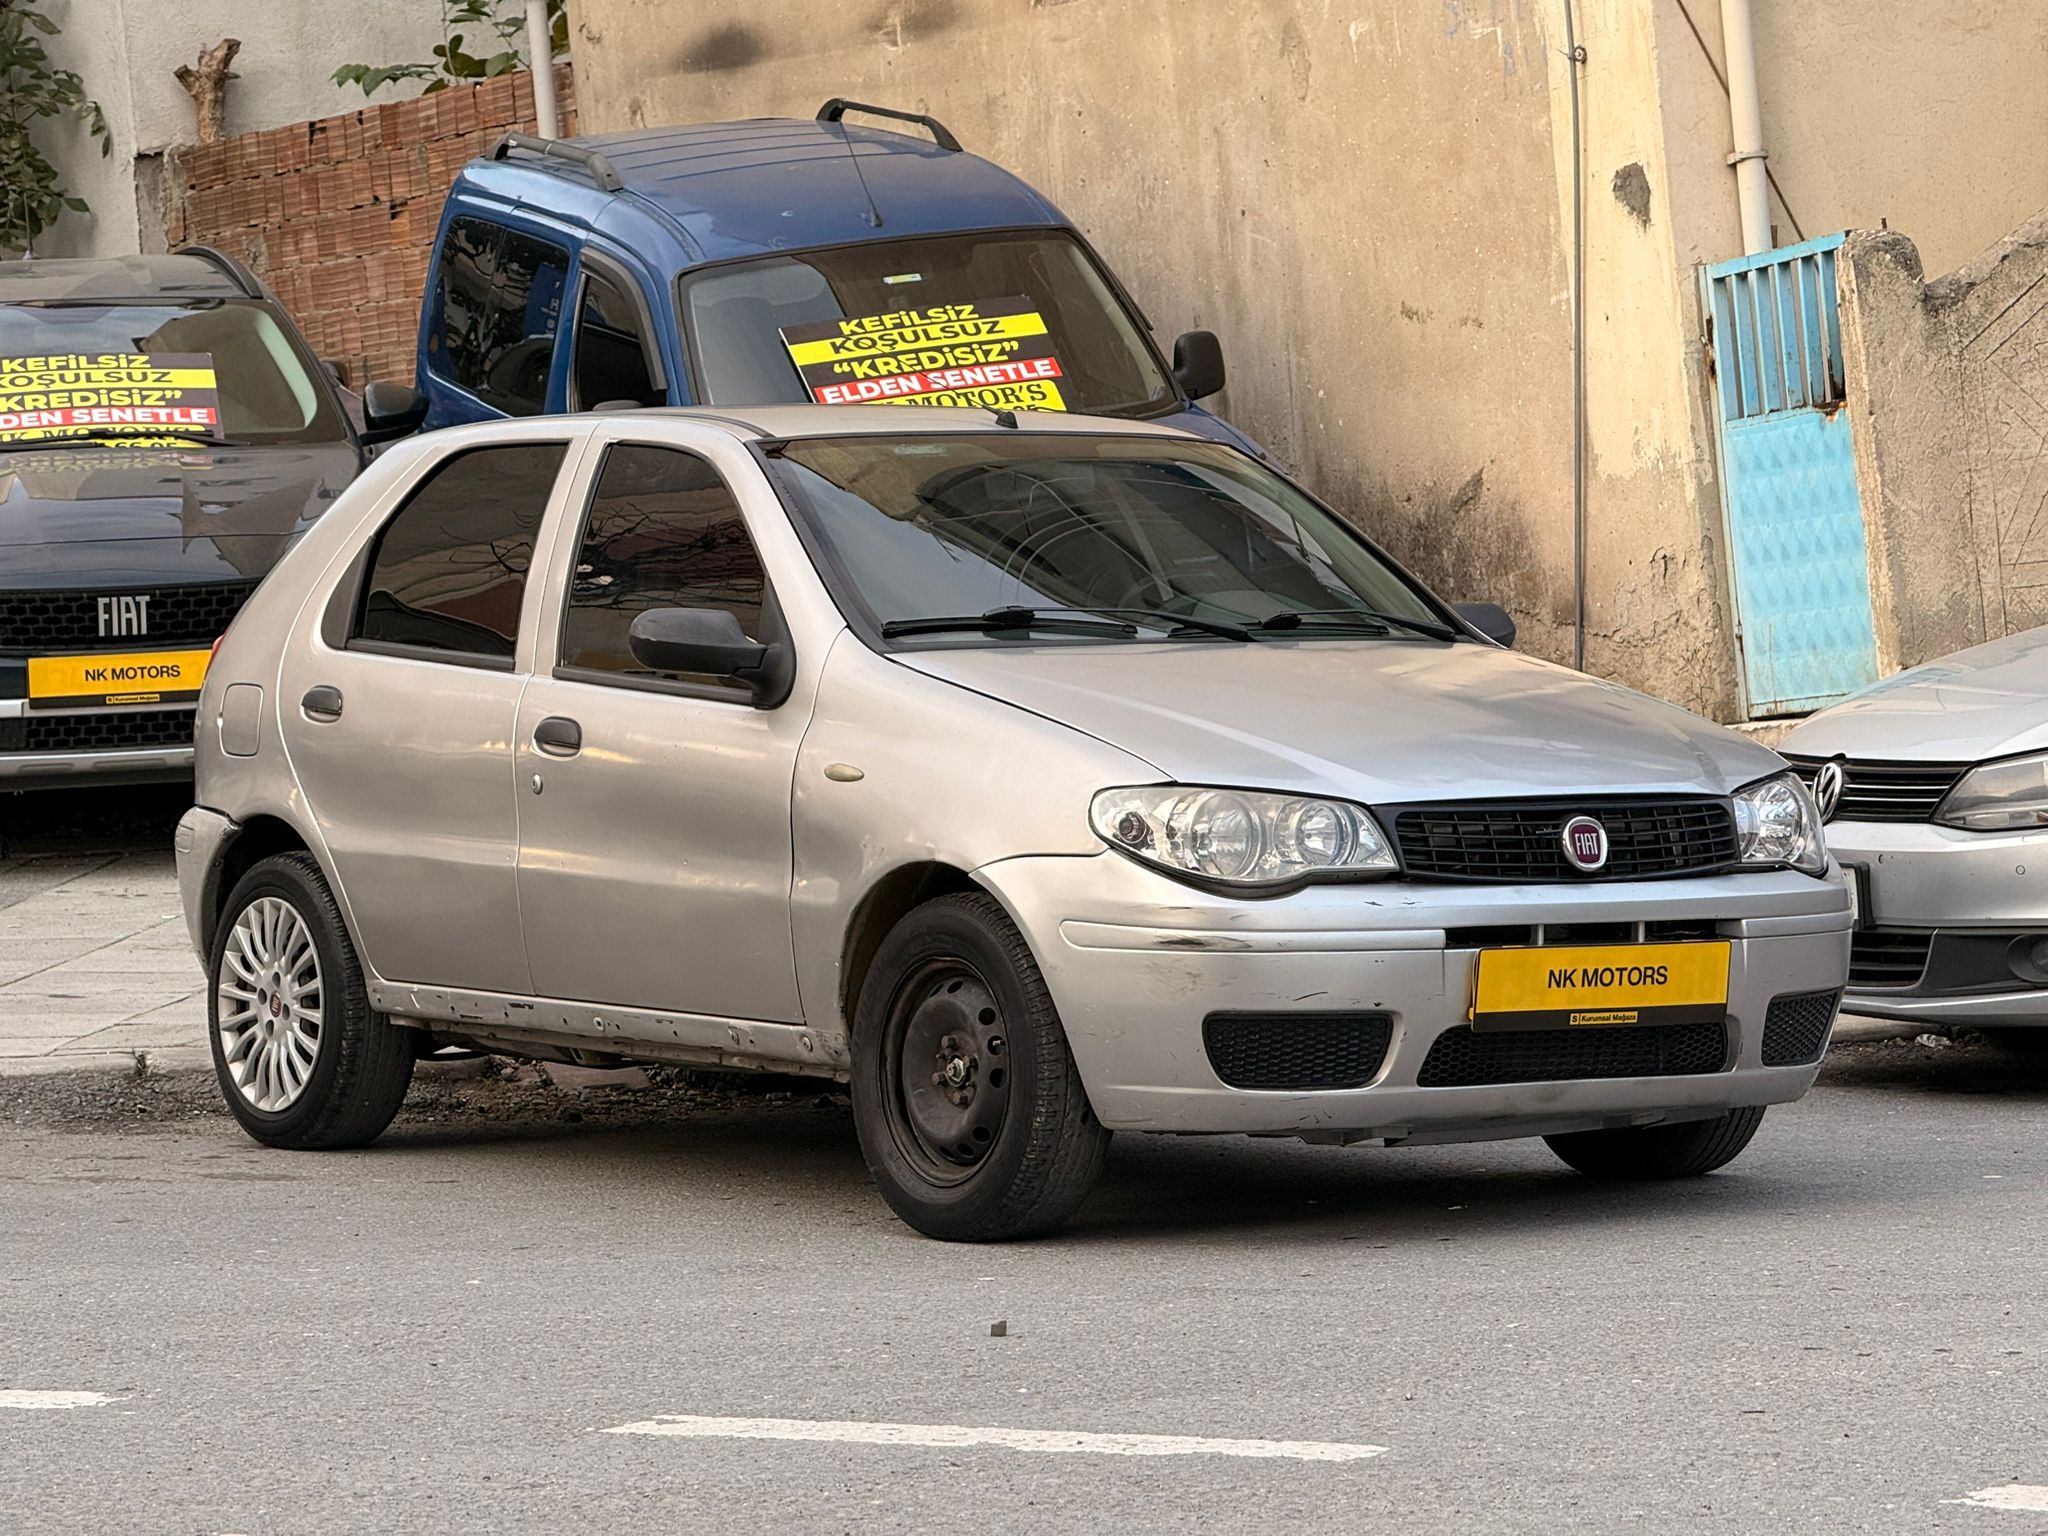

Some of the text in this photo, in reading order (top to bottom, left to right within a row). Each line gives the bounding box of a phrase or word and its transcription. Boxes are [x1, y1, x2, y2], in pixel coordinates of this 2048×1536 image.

[829, 320, 1005, 354] KOŞULSUZ
[822, 360, 1056, 404] ELDEN SENETLE
[72, 408, 209, 424] SENETLE
[97, 596, 150, 637] FIAT
[85, 665, 181, 681] NK MOTORS
[1574, 832, 1599, 855] FIAT
[1547, 965, 1668, 988] NK MOTORS
